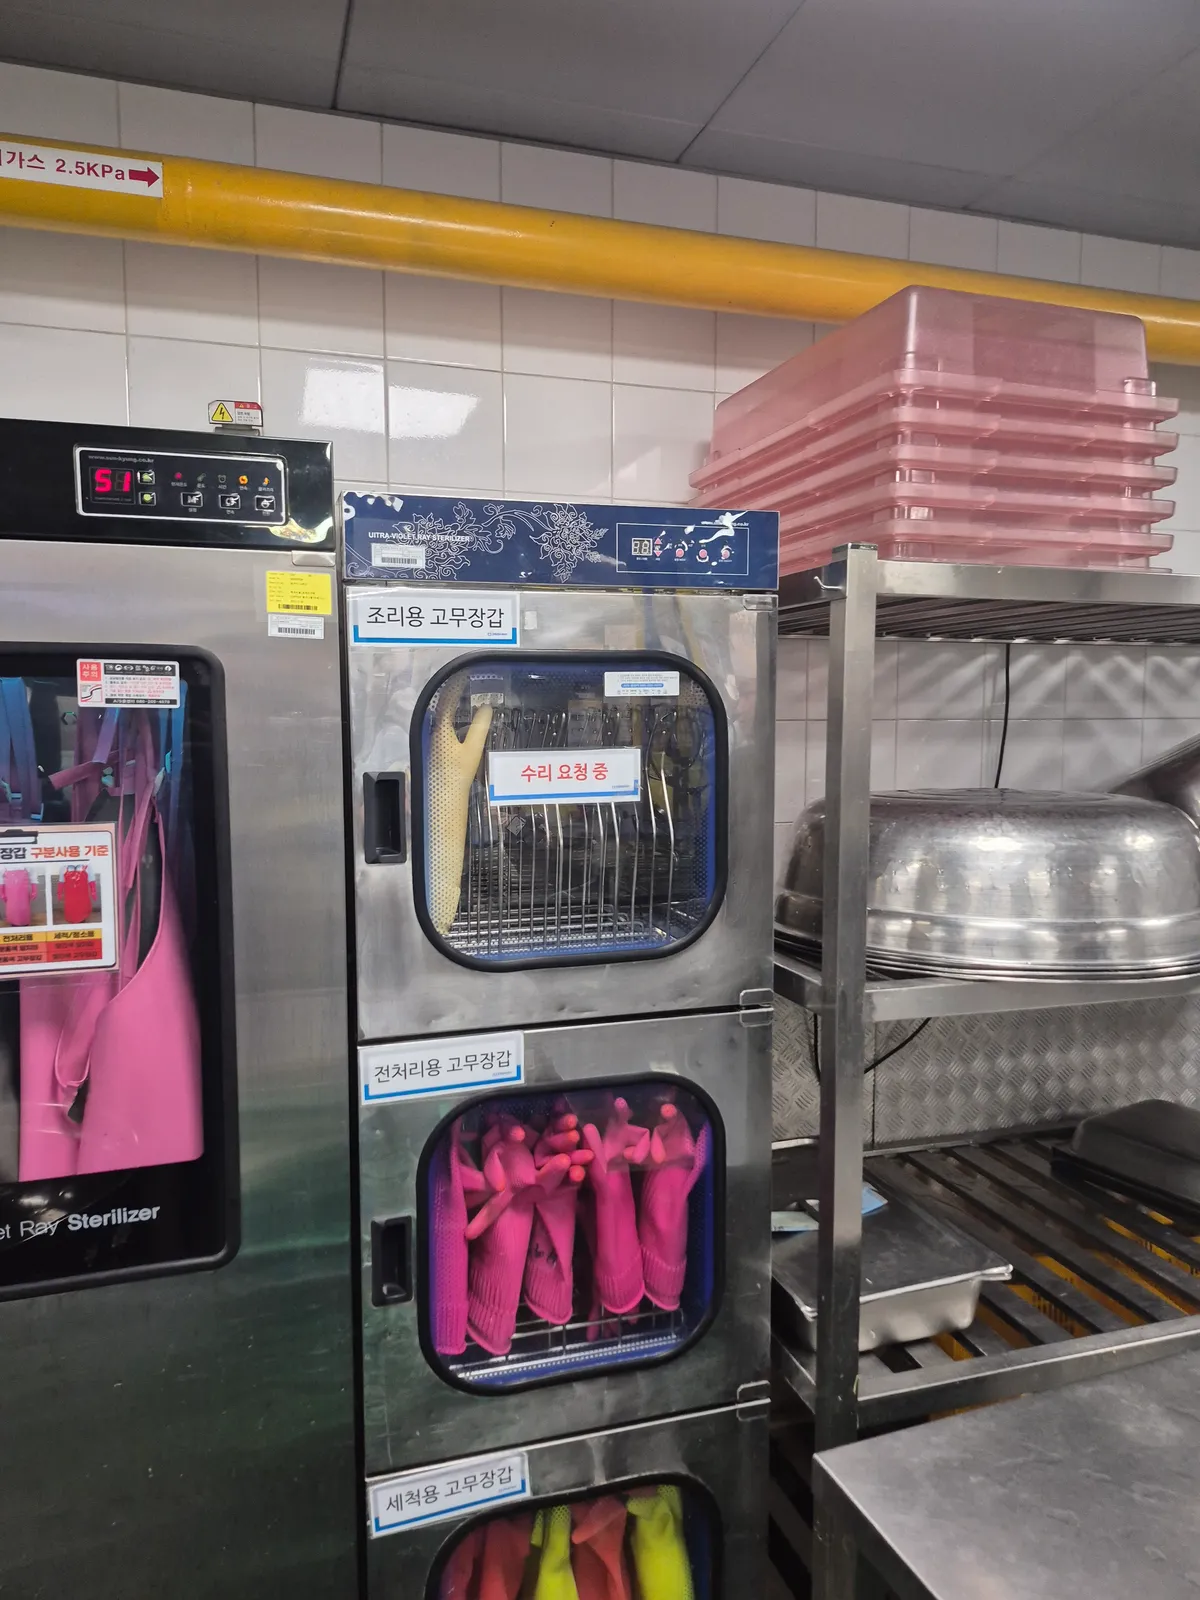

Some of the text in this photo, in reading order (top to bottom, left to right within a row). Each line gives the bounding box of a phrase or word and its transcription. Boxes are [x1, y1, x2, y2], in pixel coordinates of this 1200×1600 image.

[0, 149, 125, 180] 가스 2.5KPa
[433, 534, 470, 542] STERILIZER
[366, 606, 504, 628] 조리용 고무장갑
[520, 762, 608, 782] 수리 요청 중
[31, 845, 80, 858] 구분사용
[84, 844, 108, 857] 기준
[374, 1050, 512, 1083] 전처리용 고무장갑
[20, 1219, 61, 1236] Ray
[67, 1206, 160, 1231] Sterilizer
[386, 1466, 513, 1512] 세척용 고무장갑
